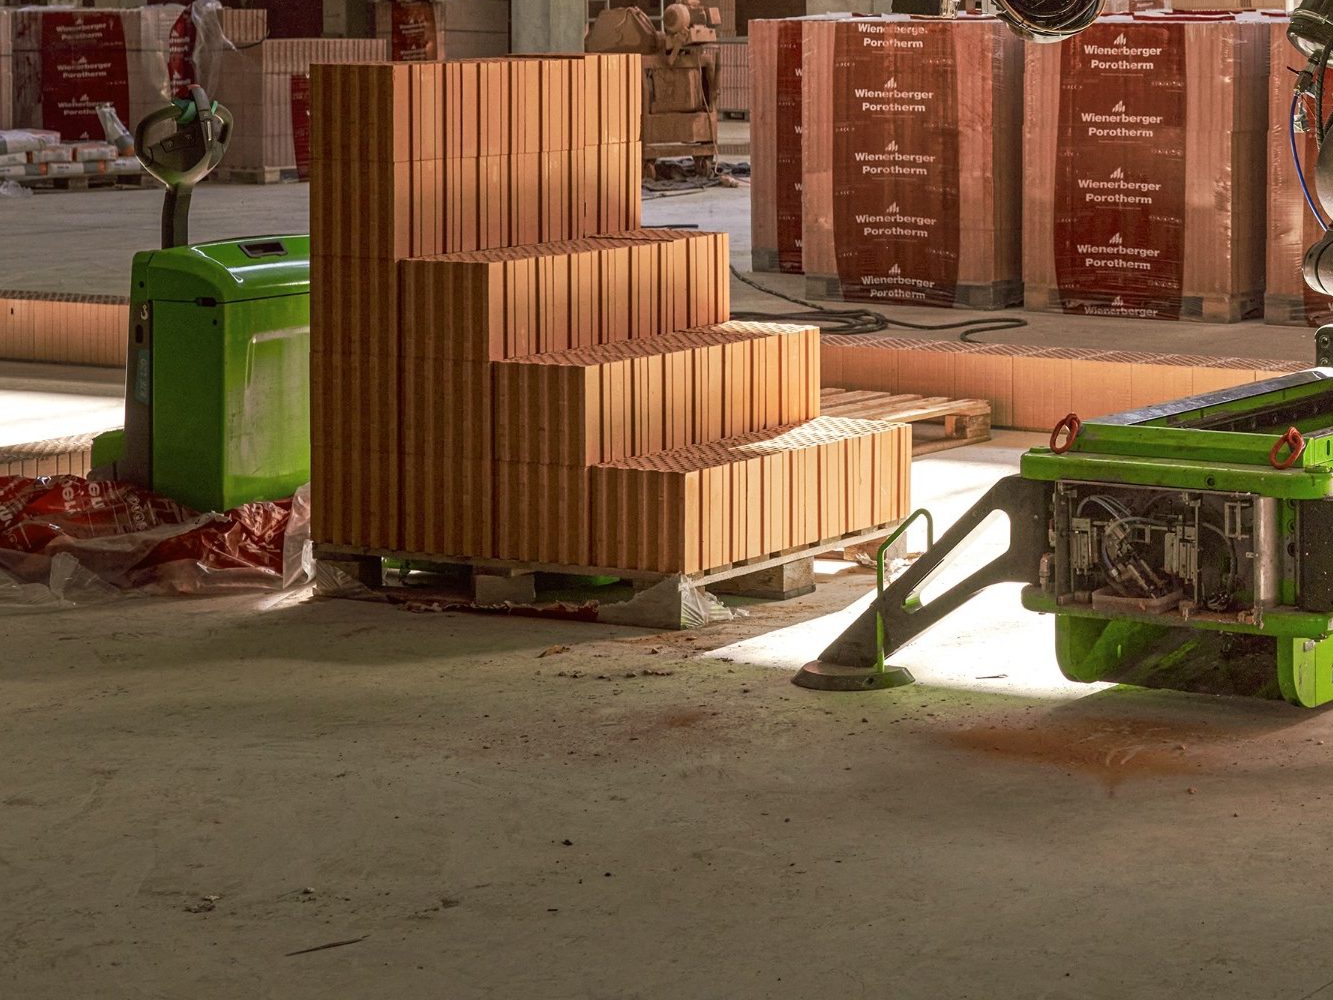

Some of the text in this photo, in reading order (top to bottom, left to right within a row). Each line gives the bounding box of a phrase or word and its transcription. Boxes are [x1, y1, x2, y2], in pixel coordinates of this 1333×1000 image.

[863, 38, 924, 49] Porotherm
[1084, 44, 1163, 57] Wienerberger
[1090, 59, 1154, 70] Porotherm
[854, 88, 935, 100] Wienerberger
[862, 102, 926, 112] Porotherm
[1081, 112, 1163, 125] Wienerberger
[1088, 126, 1154, 138] Porotherm
[854, 152, 936, 163] Wienerberger
[862, 165, 928, 176] Porotherm
[1078, 178, 1162, 191] Wienerberger
[1085, 193, 1153, 205] Porotherm
[855, 214, 938, 226] Wienerberger
[863, 226, 929, 238] Porotherm
[1076, 244, 1161, 258] Wienerberger
[1085, 258, 1151, 270] Porotherm
[860, 275, 936, 288] Wienerberger
[869, 288, 926, 300] Porotherm
[1084, 306, 1158, 318] Wienerberger
